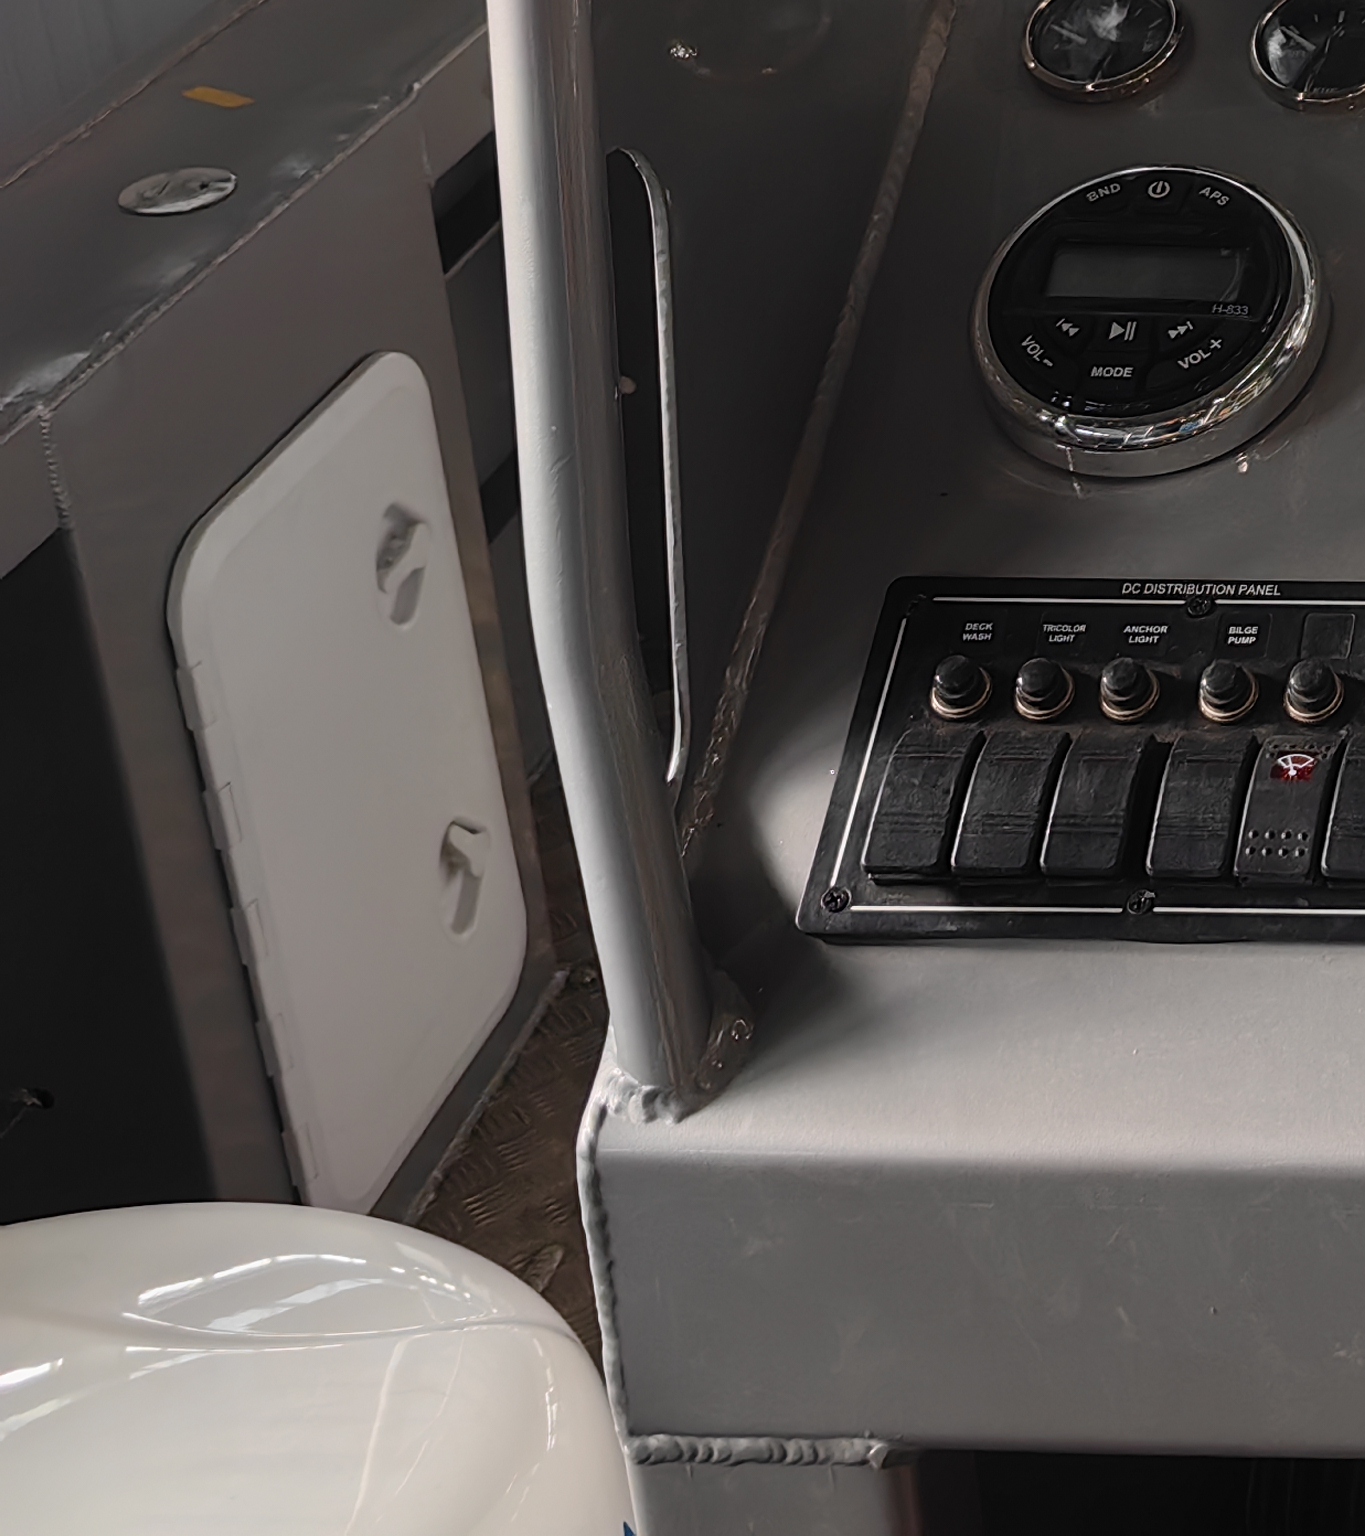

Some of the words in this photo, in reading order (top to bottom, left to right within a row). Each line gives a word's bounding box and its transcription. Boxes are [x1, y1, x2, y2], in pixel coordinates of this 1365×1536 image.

[1086, 182, 1122, 202] BND
[1198, 186, 1230, 206] APS
[1211, 303, 1249, 316] H-833
[1090, 365, 1134, 378] MODE
[1121, 582, 1142, 595] DC
[1143, 582, 1236, 596] DISTRIBUTION
[1238, 584, 1282, 596] PANEL
[965, 622, 994, 631] DECK
[1042, 623, 1087, 633] TRICOLOR
[1123, 625, 1169, 635] ANCHOR
[1228, 625, 1259, 635] BILGE
[962, 632, 992, 642] WASH
[1048, 634, 1076, 643] LIGHT
[1128, 635, 1160, 644] LIGHT
[1227, 636, 1257, 645] PUMP
